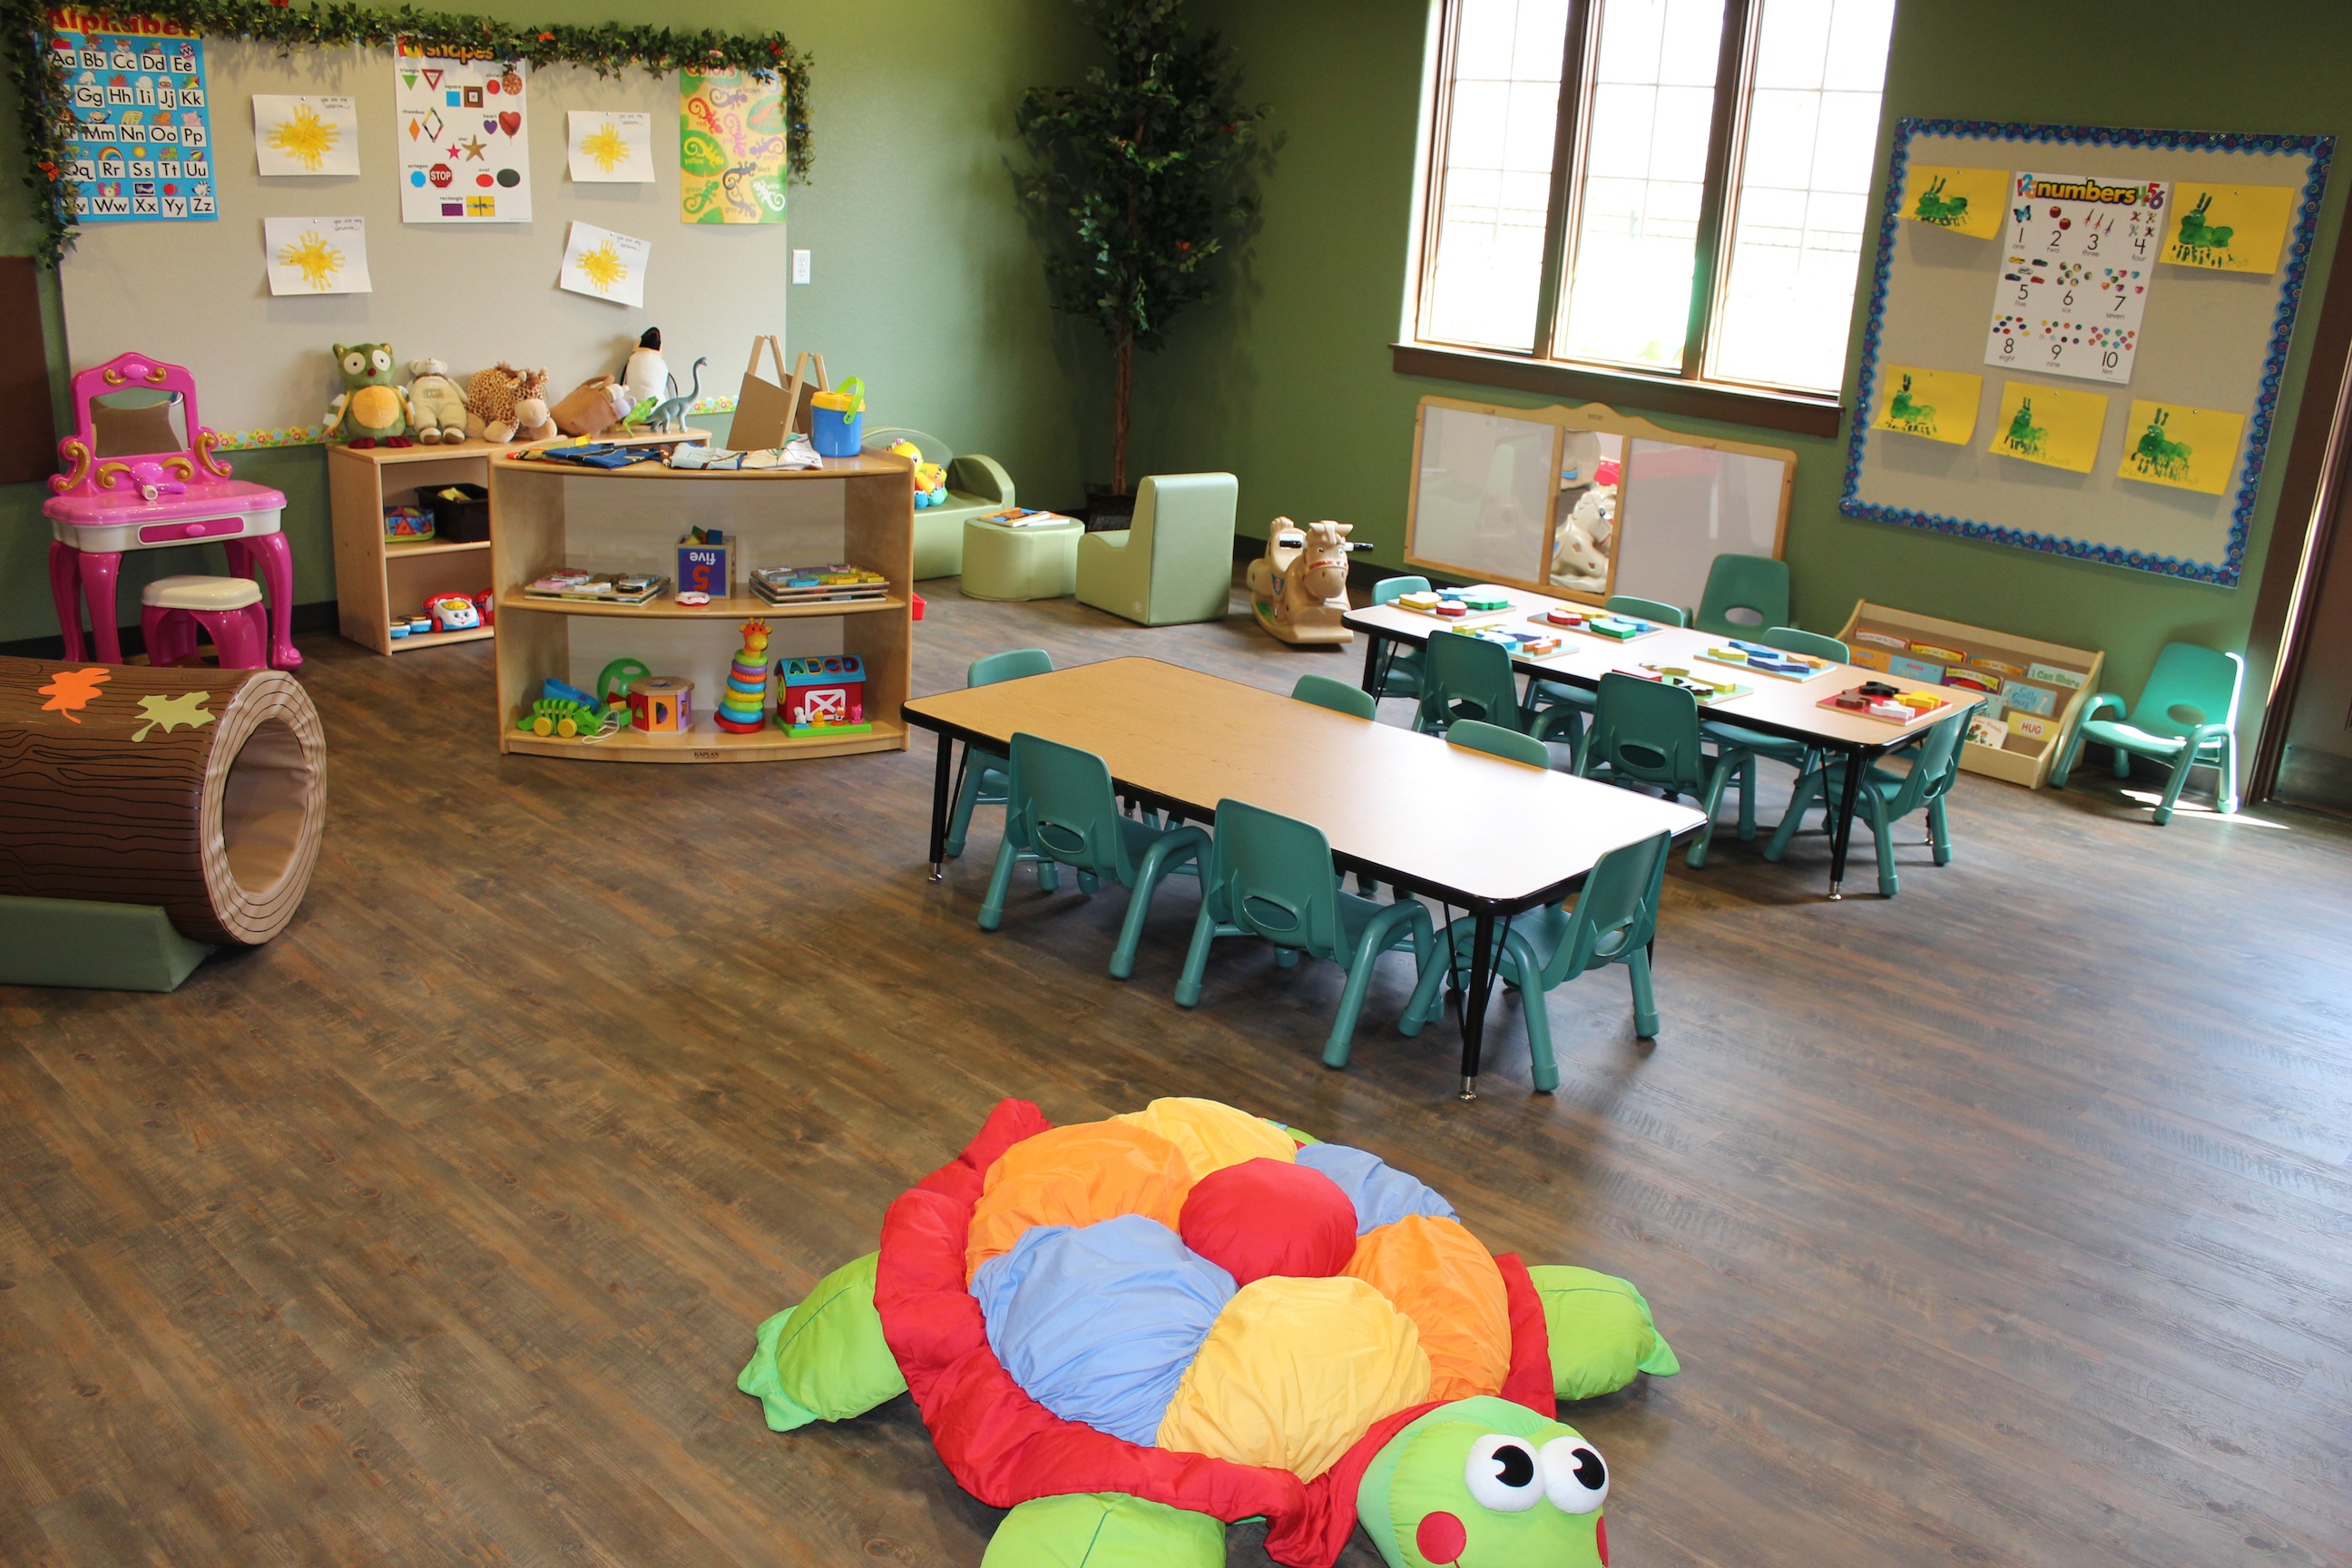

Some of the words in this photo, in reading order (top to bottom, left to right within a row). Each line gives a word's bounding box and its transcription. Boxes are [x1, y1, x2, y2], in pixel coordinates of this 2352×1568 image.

[52, 50, 75, 66] Aa
[83, 52, 104, 67] Bb
[113, 54, 135, 69] Cc
[142, 56, 165, 71] Dd
[174, 56, 193, 72] Ee
[77, 87, 103, 106] Gg
[109, 88, 132, 103] Hh
[139, 89, 152, 104] Ii
[160, 89, 175, 108] Jj
[181, 91, 202, 106] Kk
[84, 125, 115, 140] Mm
[121, 126, 144, 142] Nn
[151, 127, 177, 142] Oo
[184, 128, 203, 145] Pp
[103, 162, 121, 176] Rr
[132, 162, 152, 177] Ss
[161, 162, 177, 177] Tt
[186, 162, 207, 177] Uu
[685, 157, 704, 165] yellow
[430, 171, 452, 181] STOP
[2036, 178, 2137, 206] numbers
[93, 199, 127, 212] Ww
[135, 199, 157, 212] Xx
[164, 199, 184, 216] Yy
[193, 198, 212, 211] Zz
[2019, 228, 2024, 242] 1
[2051, 230, 2062, 247] 2
[2087, 233, 2099, 250] 3
[2134, 238, 2146, 255] 4
[2082, 250, 2100, 258] three
[2132, 254, 2147, 262] four
[2017, 284, 2029, 299] 5
[2063, 289, 2073, 306] 6
[2113, 295, 2126, 311] 7
[1999, 353, 2015, 362] eight
[2004, 338, 2014, 354] 8
[2052, 344, 2062, 360] 9
[2102, 351, 2118, 368] 10
[690, 552, 716, 565] five
[692, 564, 711, 591] 5
[2037, 671, 2053, 681] Can
[2054, 673, 2081, 688] Share
[2021, 722, 2042, 734] HUG
